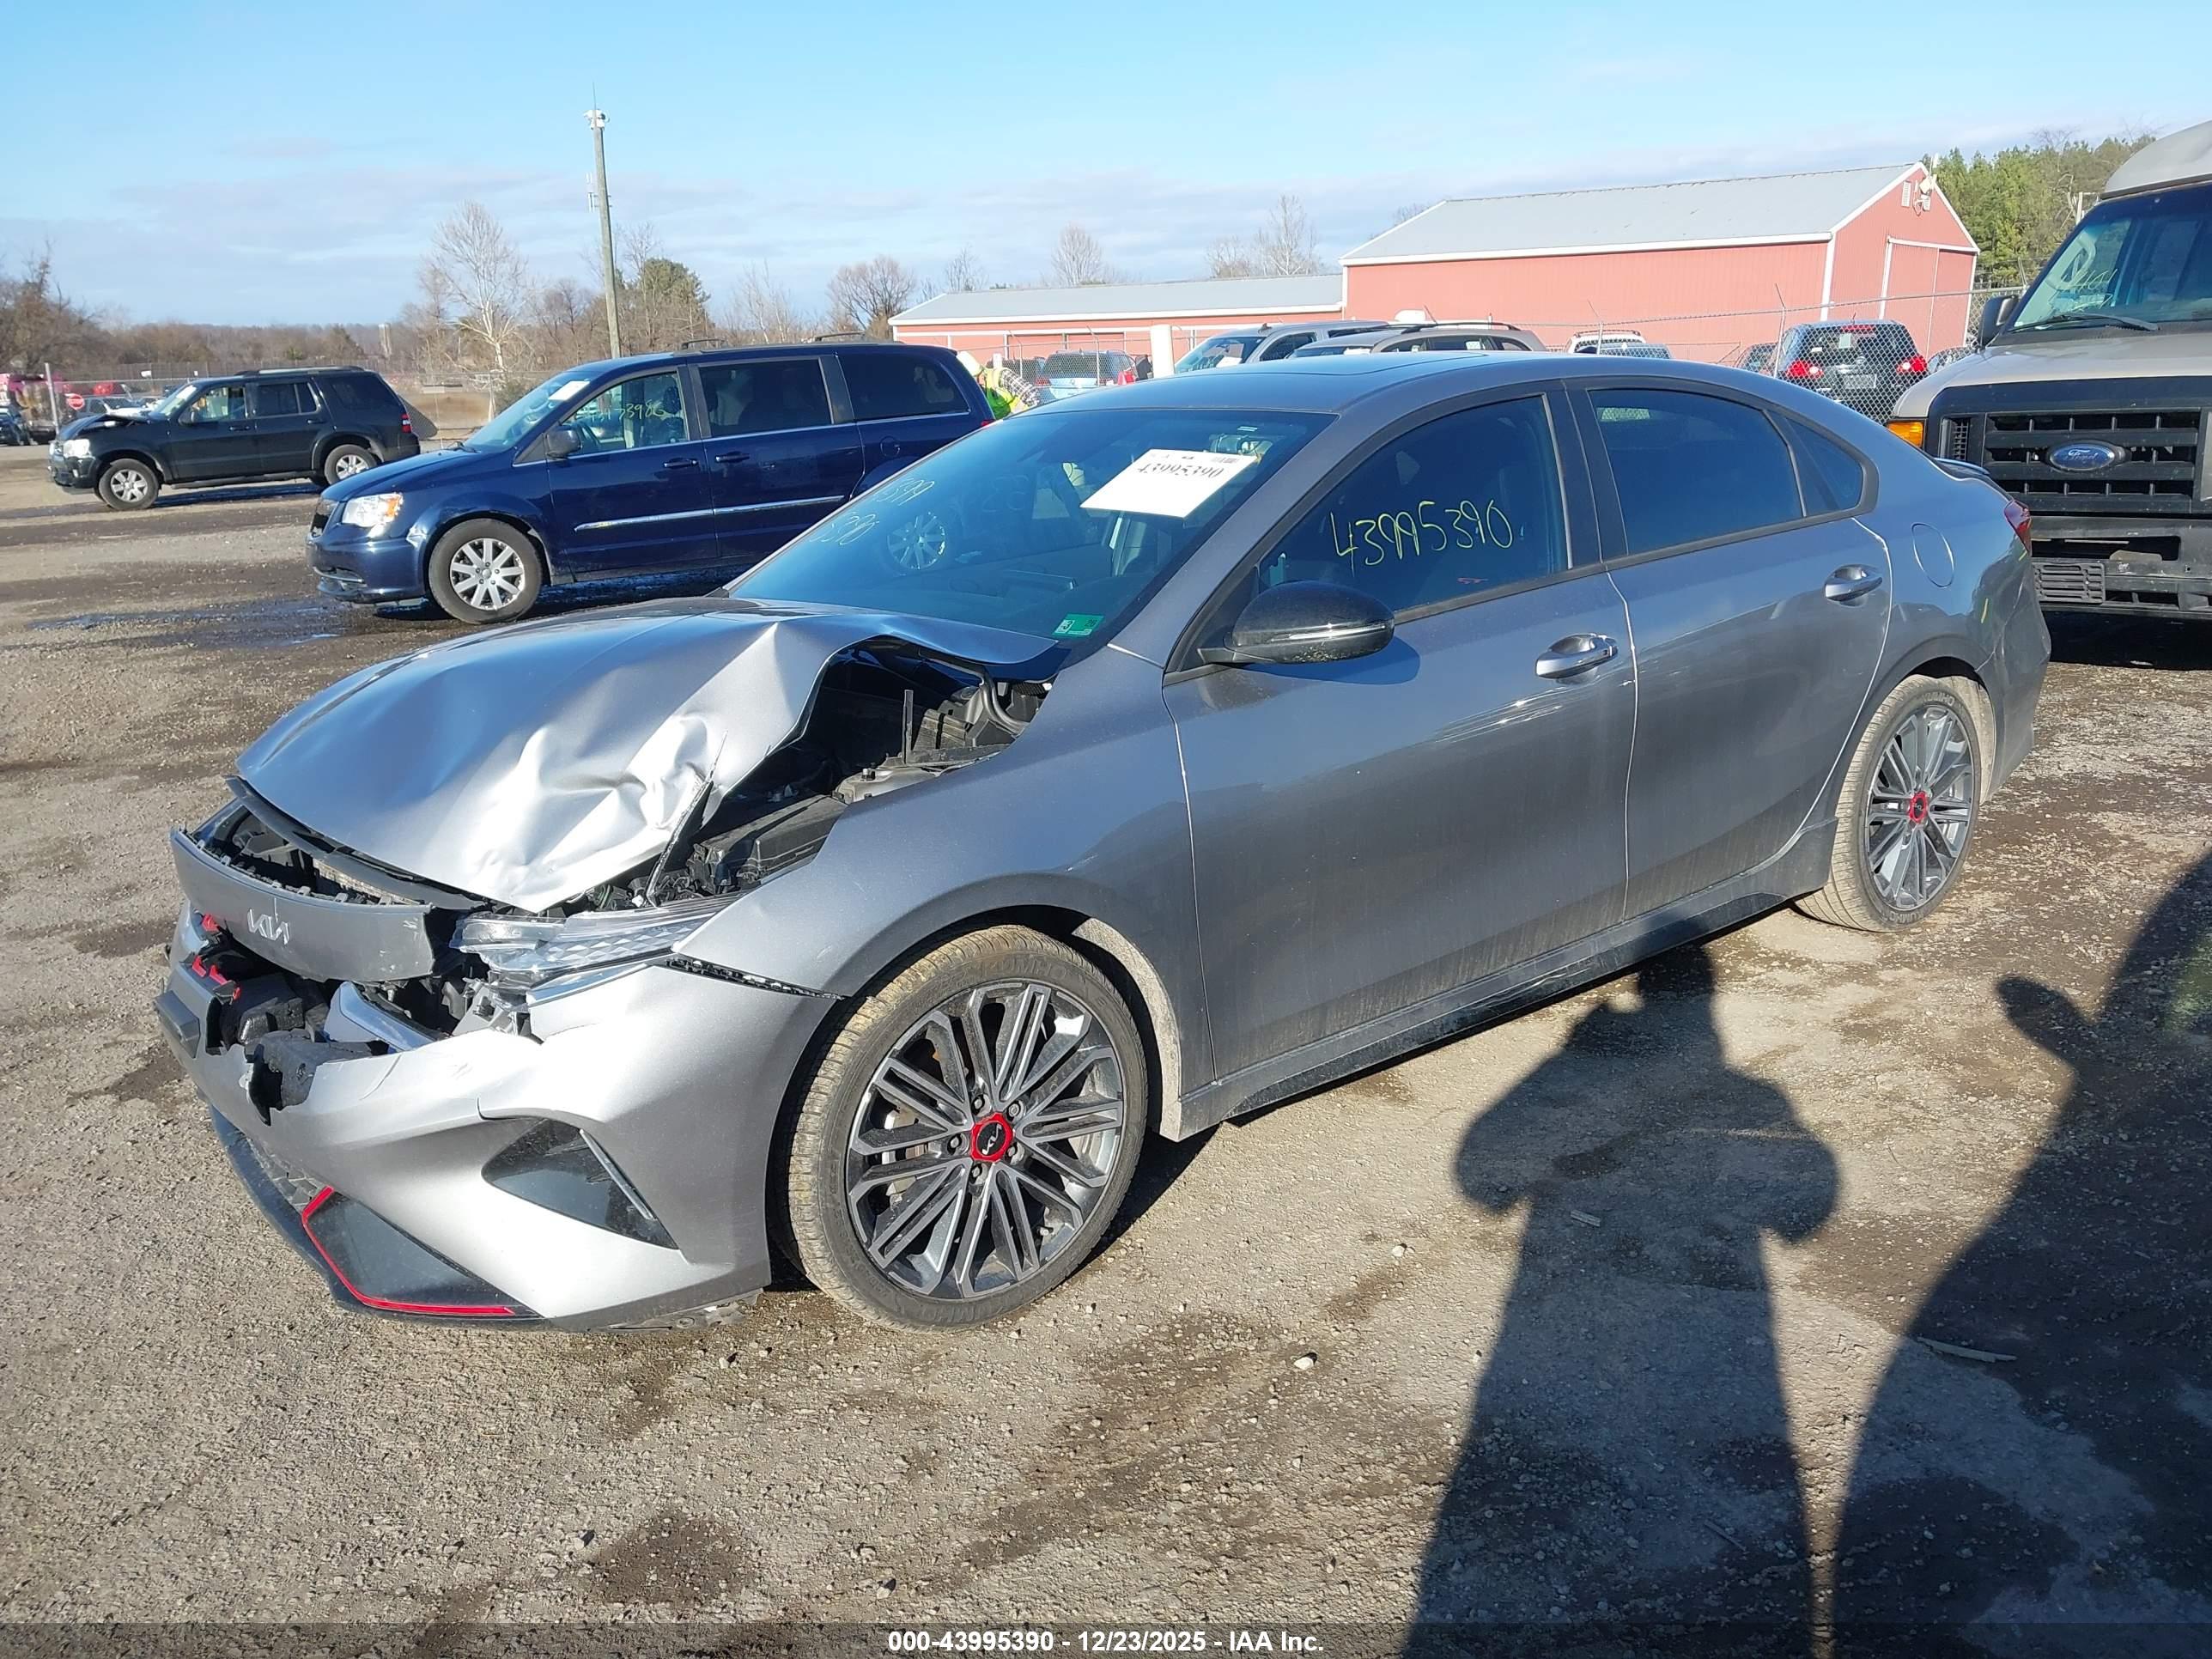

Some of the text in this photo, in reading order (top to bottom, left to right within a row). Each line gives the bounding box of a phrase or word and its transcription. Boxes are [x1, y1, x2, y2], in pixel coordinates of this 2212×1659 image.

[2066, 447, 2097, 461] Ford
[1137, 463, 1225, 478] 43995390
[1330, 500, 1513, 577] 43995390
[1923, 691, 1955, 706] KUMHO
